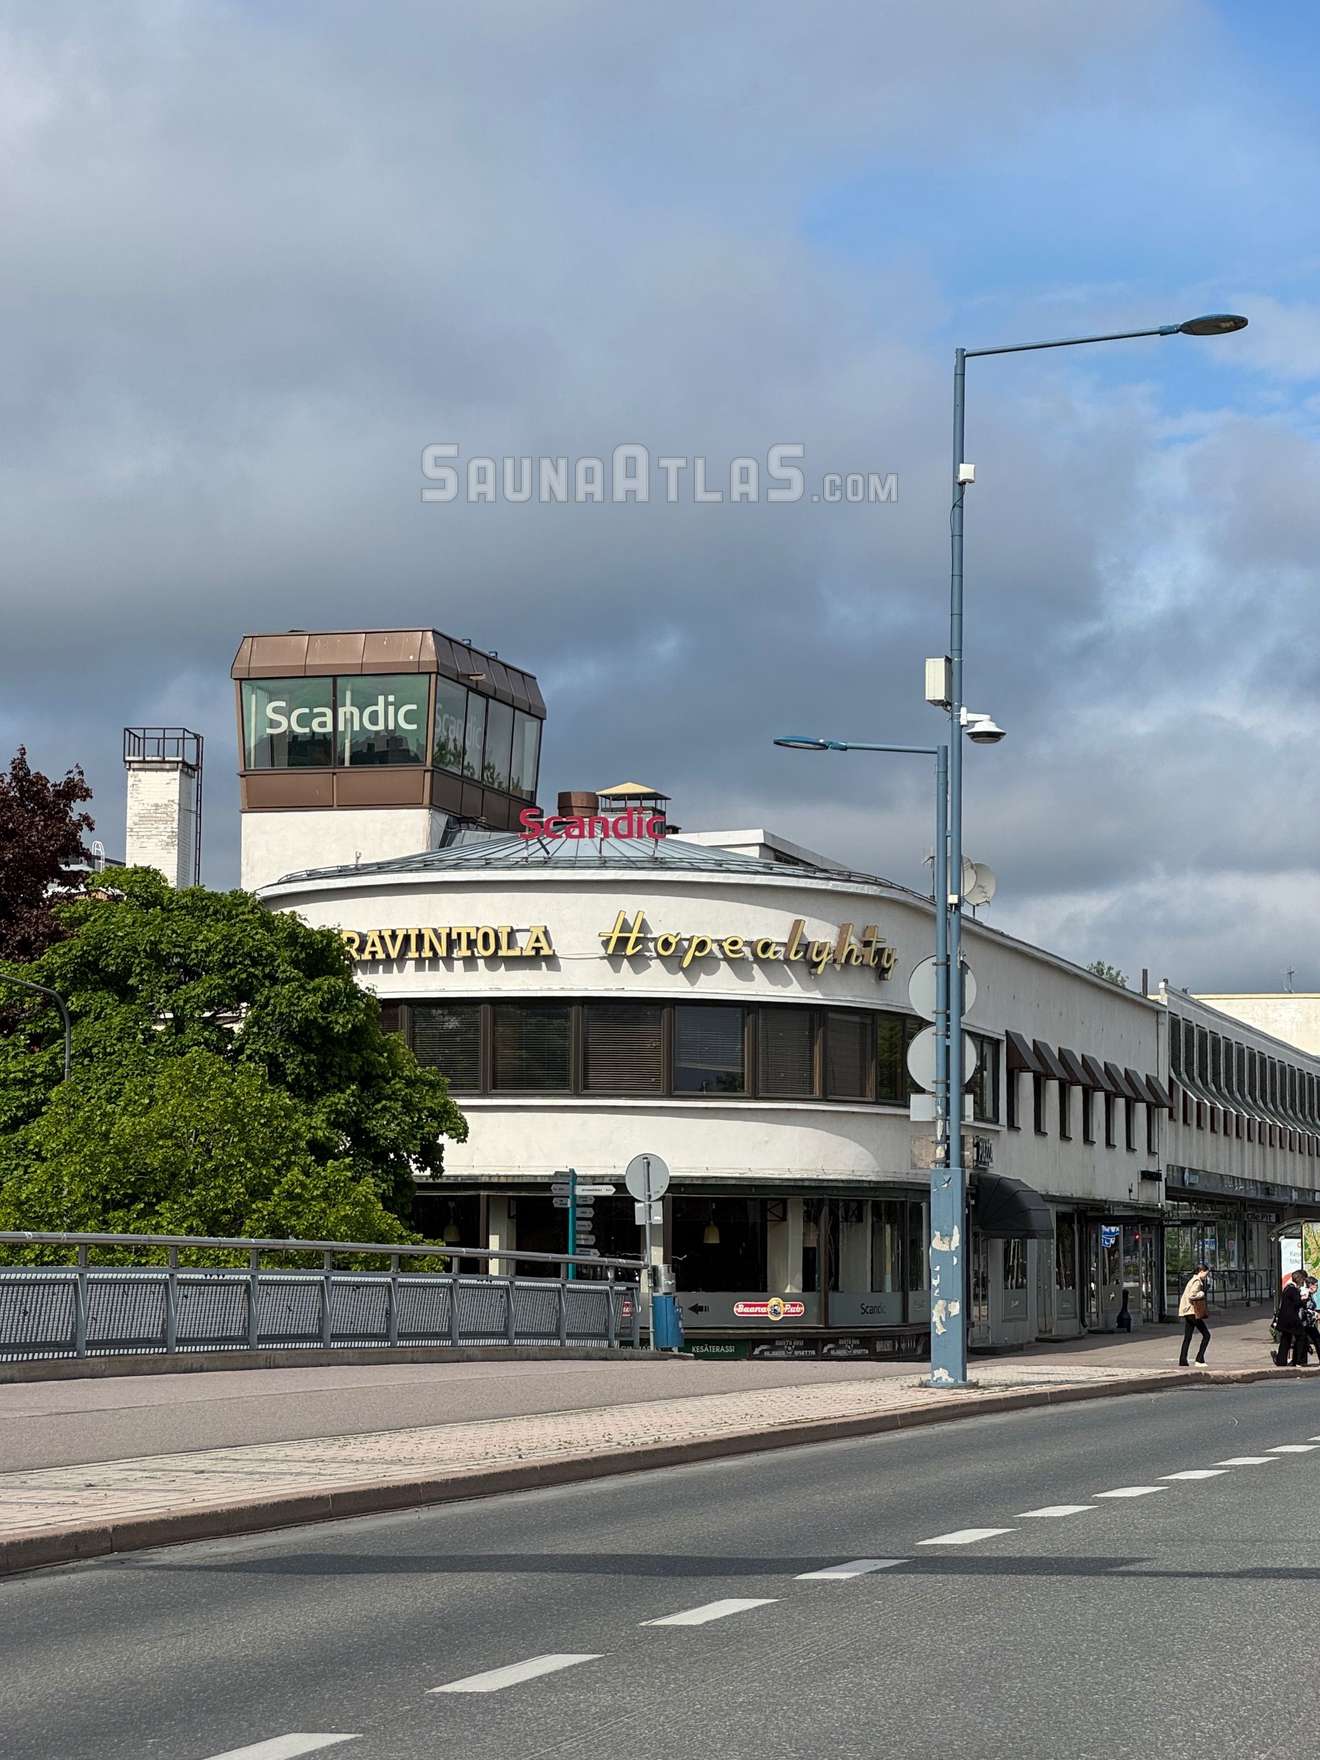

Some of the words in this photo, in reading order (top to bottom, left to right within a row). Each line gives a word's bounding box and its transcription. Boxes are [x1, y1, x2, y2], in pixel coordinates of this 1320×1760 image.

[265, 695, 418, 735] Scandic
[518, 805, 667, 841] Scandic
[340, 926, 554, 960] RAVINTOLA
[598, 910, 898, 981] Hopealyhty
